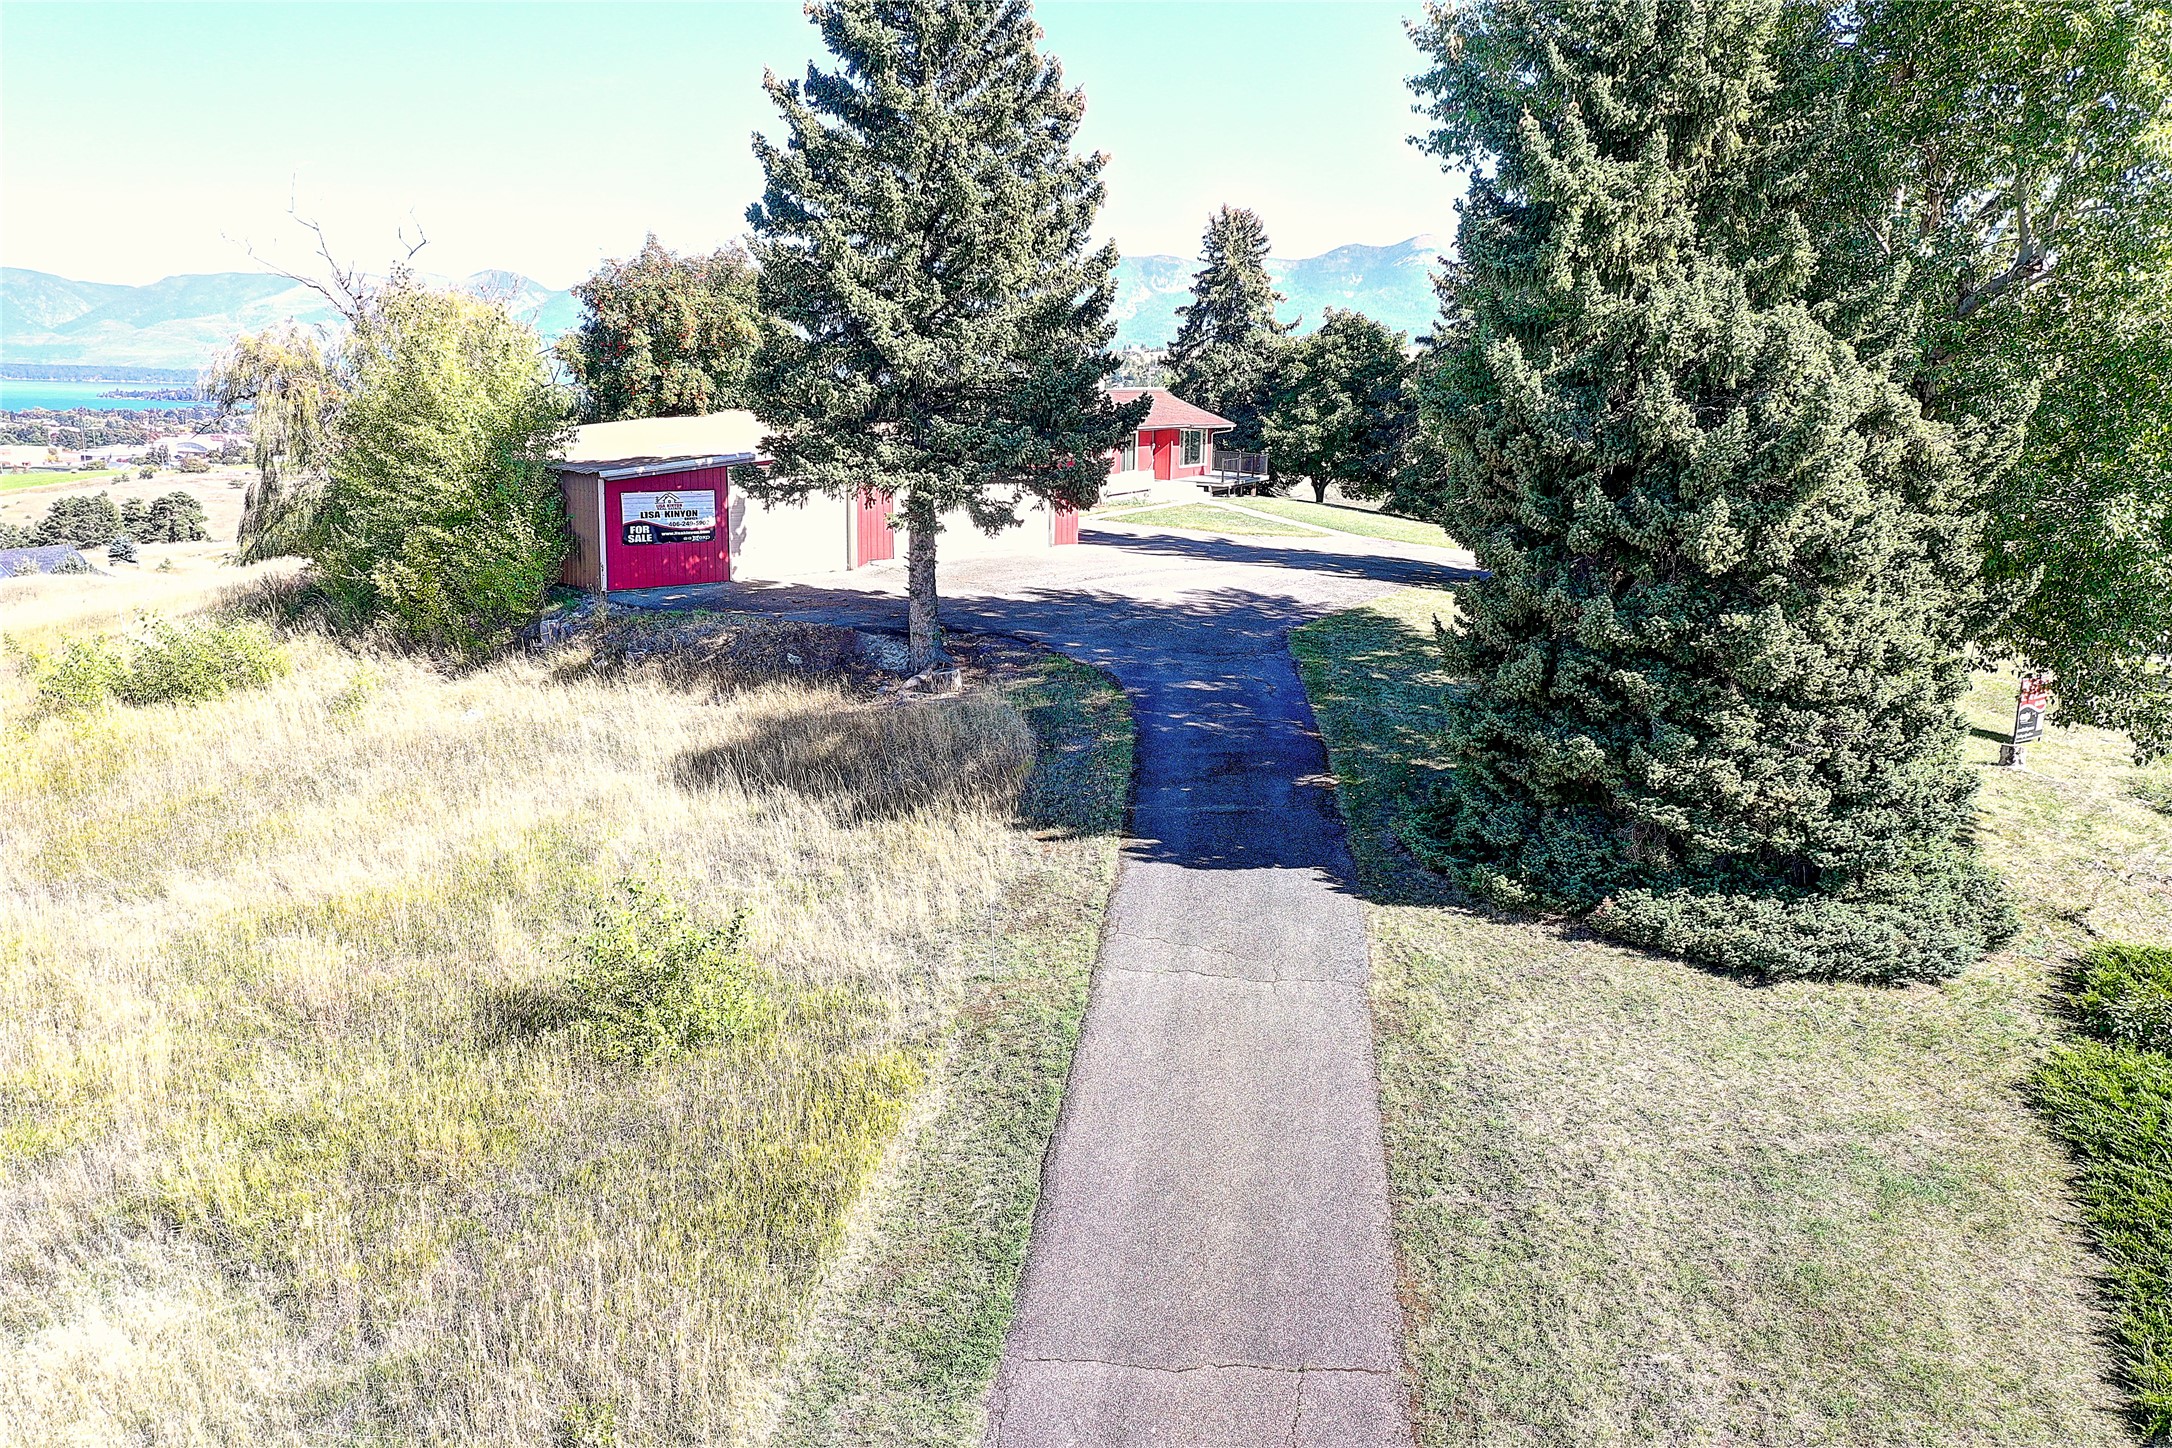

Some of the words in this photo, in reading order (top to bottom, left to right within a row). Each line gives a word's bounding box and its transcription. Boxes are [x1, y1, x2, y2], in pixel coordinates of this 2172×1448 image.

[640, 511, 661, 519] LISA
[664, 510, 698, 518] KINYON
[630, 526, 650, 535] FOR
[628, 534, 653, 543] SALE
